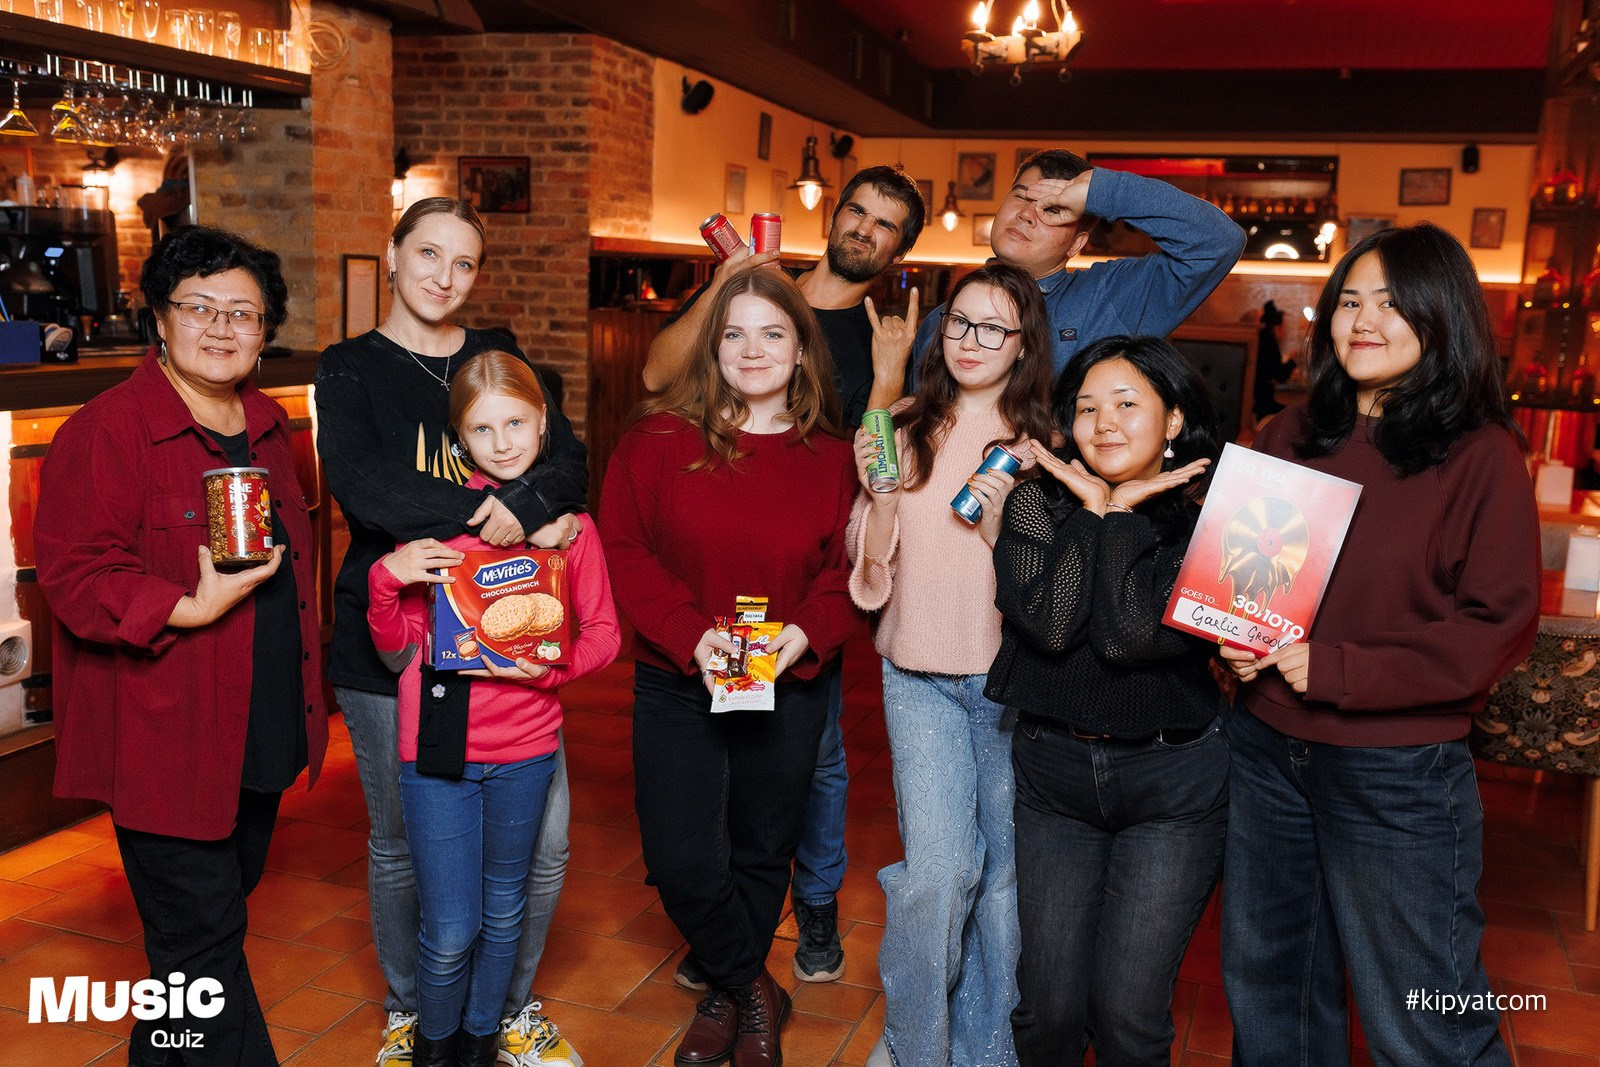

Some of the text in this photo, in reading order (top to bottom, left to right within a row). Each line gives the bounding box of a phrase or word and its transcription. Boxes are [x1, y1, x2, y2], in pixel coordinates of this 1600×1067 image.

[481, 560, 532, 584] McVitie's
[480, 580, 540, 599] CHOCOSANDWICH
[1180, 586, 1220, 607] GOES TO...
[1191, 604, 1240, 637] Garlic
[1233, 594, 1305, 640] ЗОЛОТО
[441, 650, 457, 660] 12x
